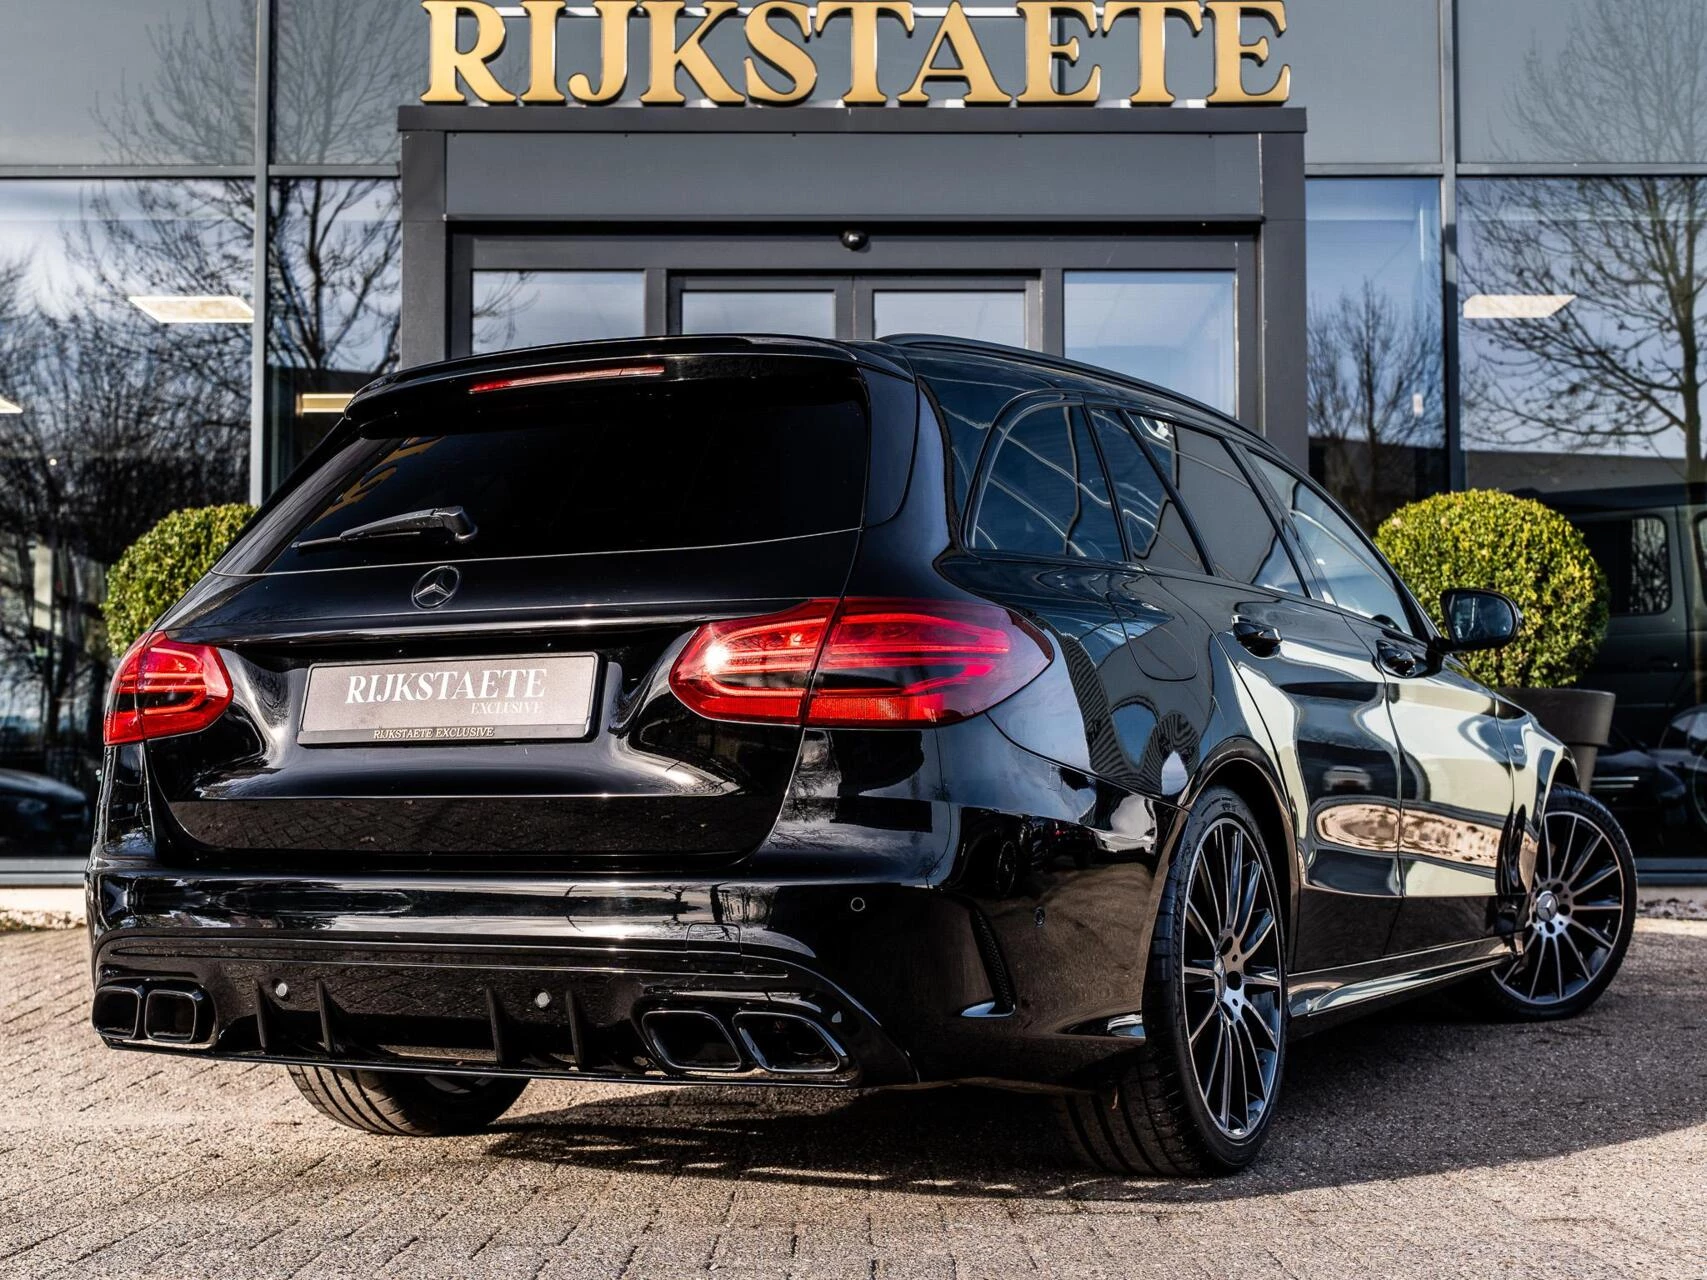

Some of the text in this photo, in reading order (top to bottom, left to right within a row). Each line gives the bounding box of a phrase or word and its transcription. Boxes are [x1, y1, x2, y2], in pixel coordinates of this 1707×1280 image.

[421, 0, 1292, 105] RIJKSTAETE
[345, 668, 547, 704] RIJKSTAETE
[471, 701, 543, 715] EXCLUSIVE
[373, 726, 495, 739] RIJKSTAETE EXCLUSIVE
